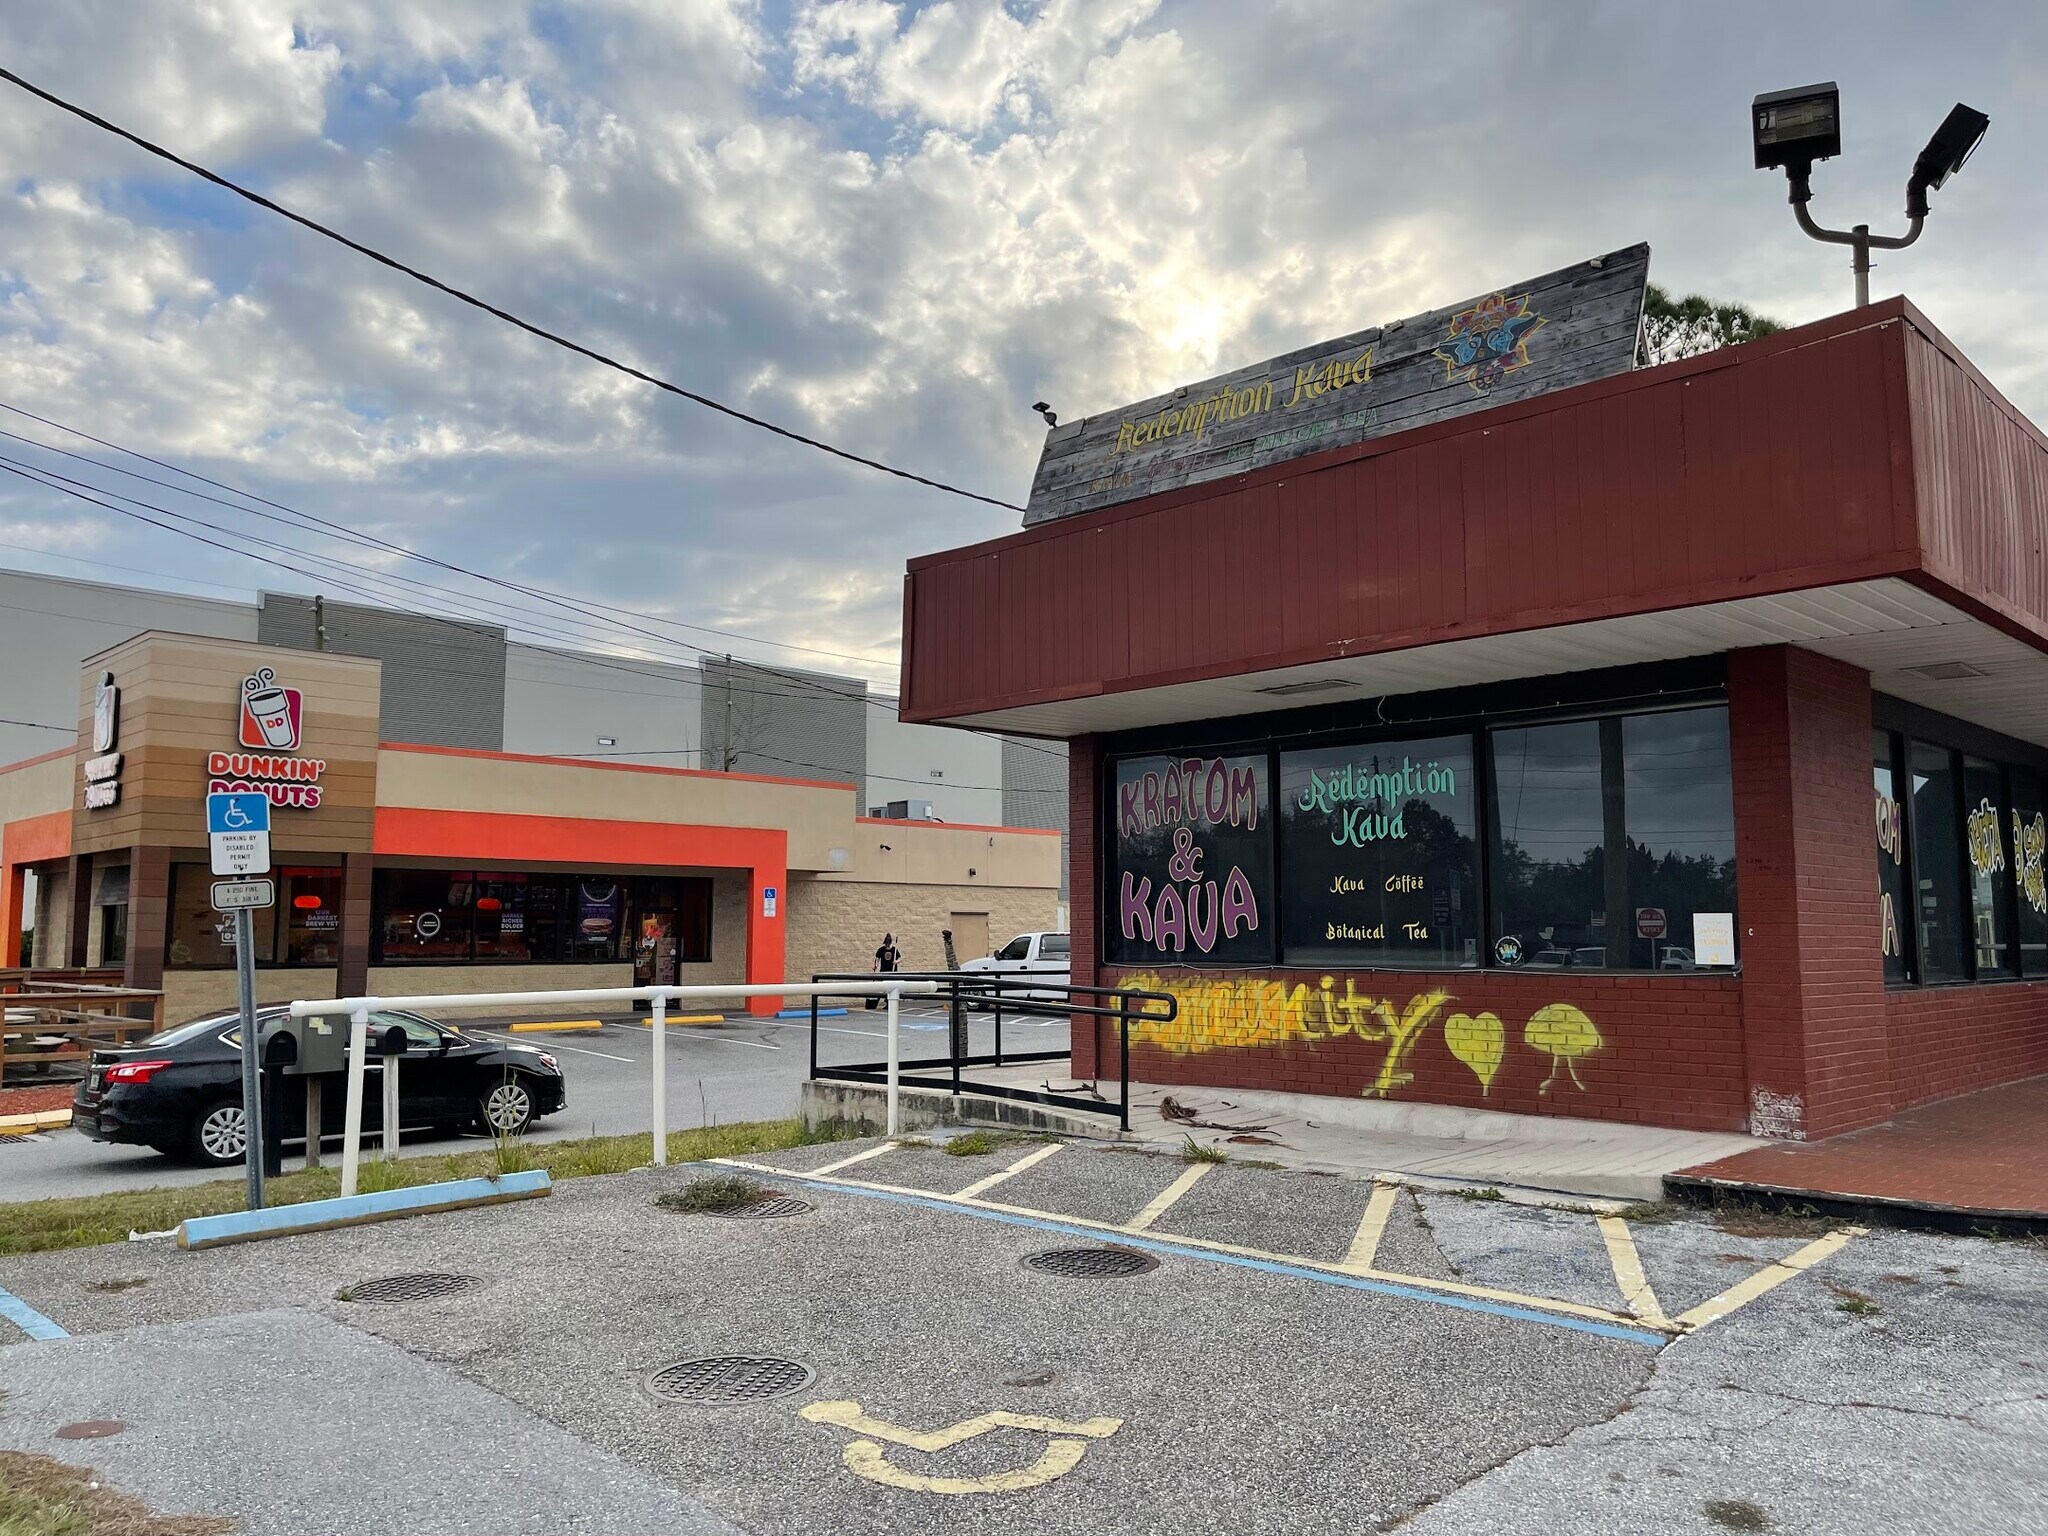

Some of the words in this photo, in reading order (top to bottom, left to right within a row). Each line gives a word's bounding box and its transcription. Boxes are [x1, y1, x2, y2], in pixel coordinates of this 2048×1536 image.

[1108, 379, 1273, 455] Redemption
[1284, 346, 1374, 407] Kava
[266, 717, 284, 729] DD
[209, 752, 326, 781] DUNKIN'
[1121, 757, 1258, 837] KRATOM
[1331, 807, 1408, 848] Kava
[1169, 828, 1204, 882] &
[1330, 875, 1365, 894] Kava
[1120, 866, 1259, 953] KAVA
[1402, 920, 1428, 940] Tea
